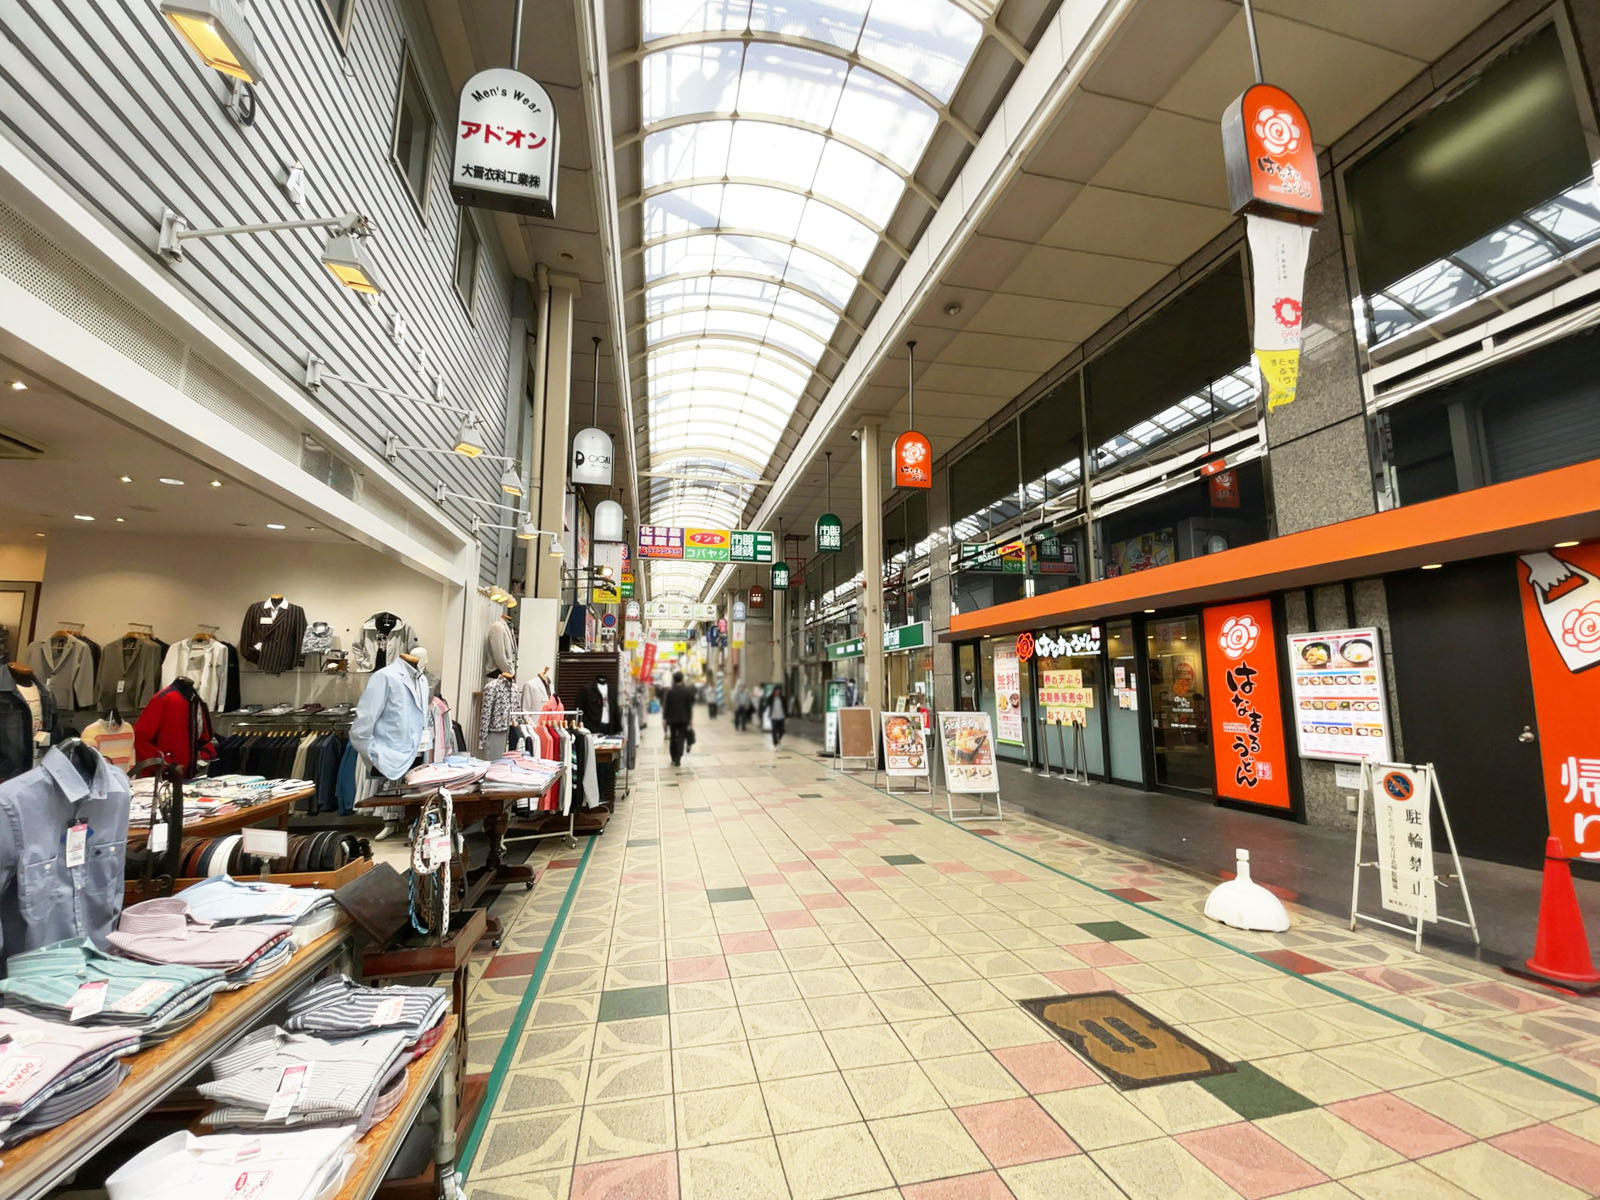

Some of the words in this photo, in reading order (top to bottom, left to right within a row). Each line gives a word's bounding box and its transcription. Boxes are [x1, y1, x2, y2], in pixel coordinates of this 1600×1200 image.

[471, 86, 507, 102] Men's
[513, 90, 542, 114] Wear
[461, 120, 547, 149] アドオン
[686, 549, 728, 560] コバヤシ
